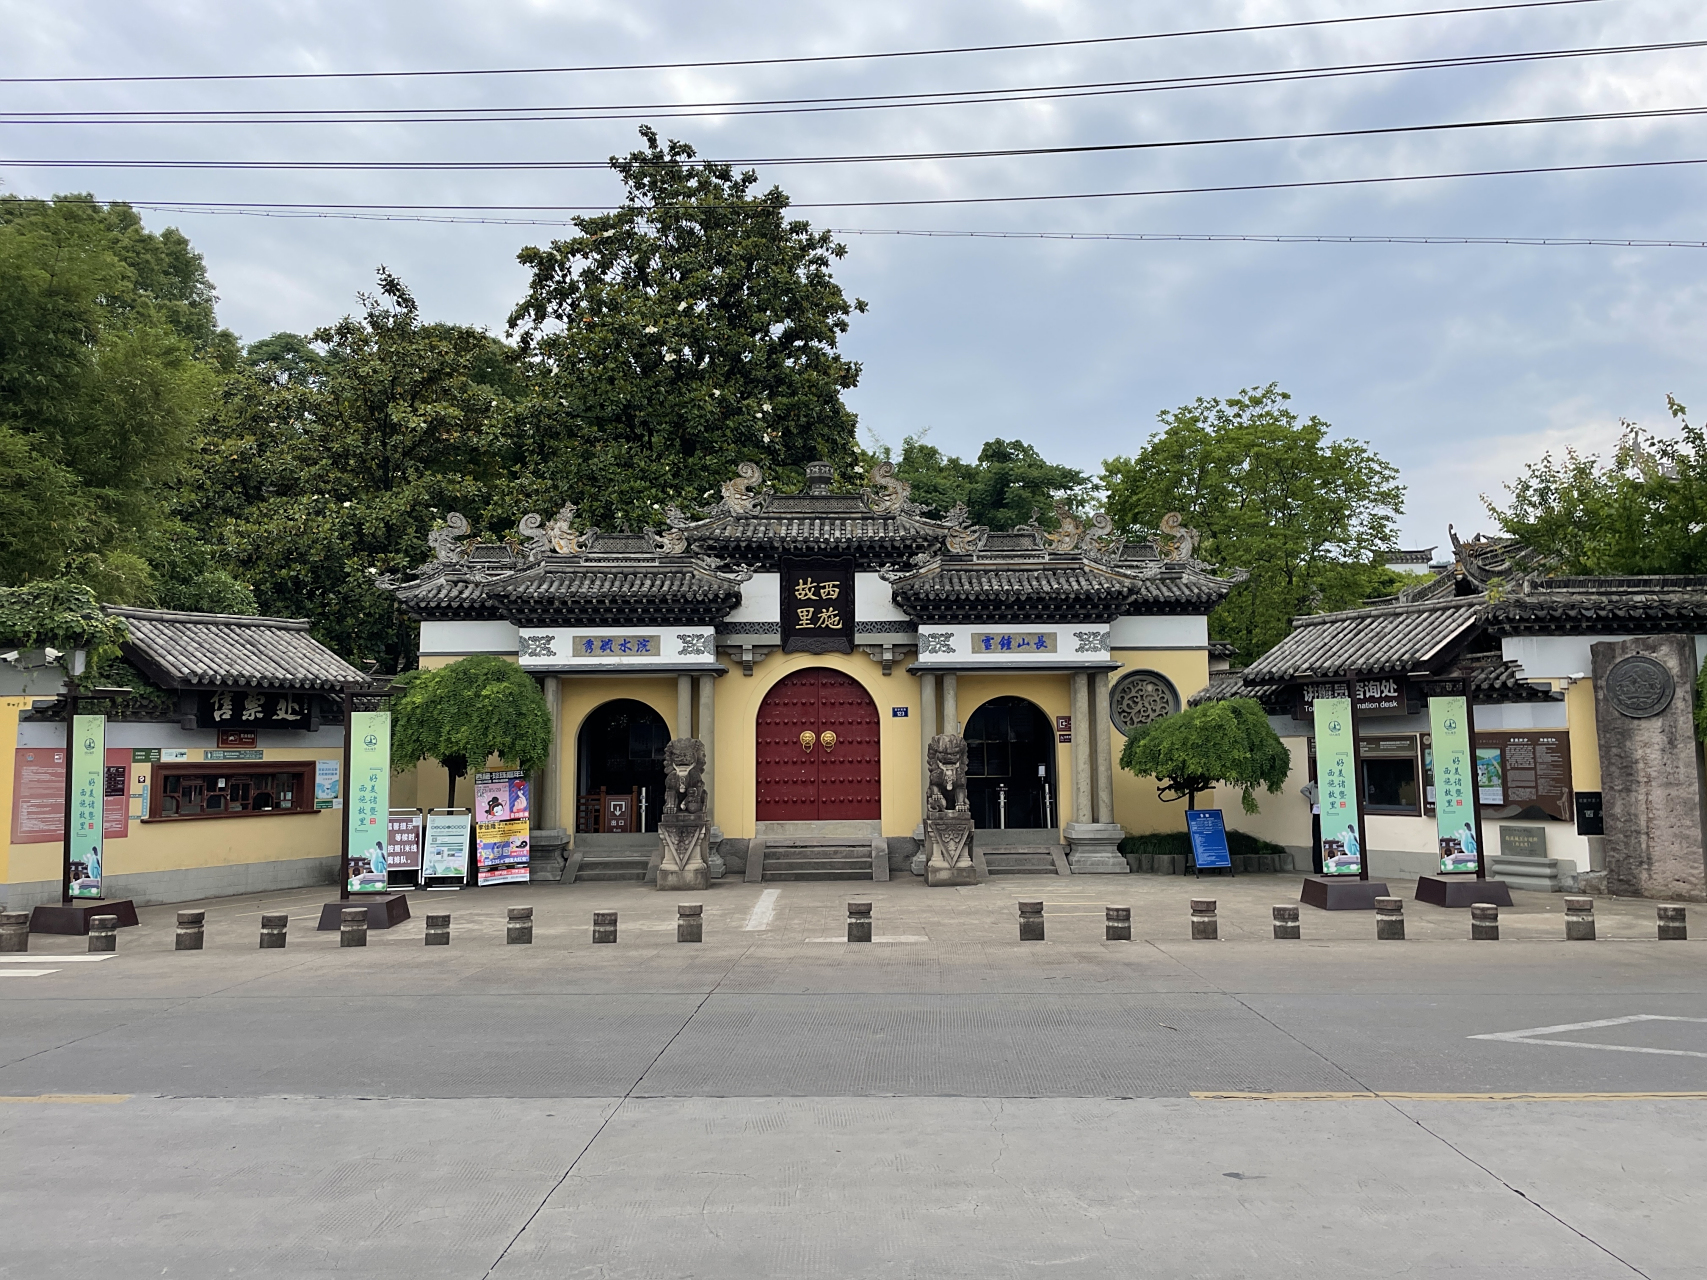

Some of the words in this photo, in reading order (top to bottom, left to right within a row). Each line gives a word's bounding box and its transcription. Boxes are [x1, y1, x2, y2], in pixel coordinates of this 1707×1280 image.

[795, 577, 820, 629] 故里
[815, 581, 843, 629] 西施
[210, 690, 302, 721] 售票处
[1380, 700, 1398, 708] desk
